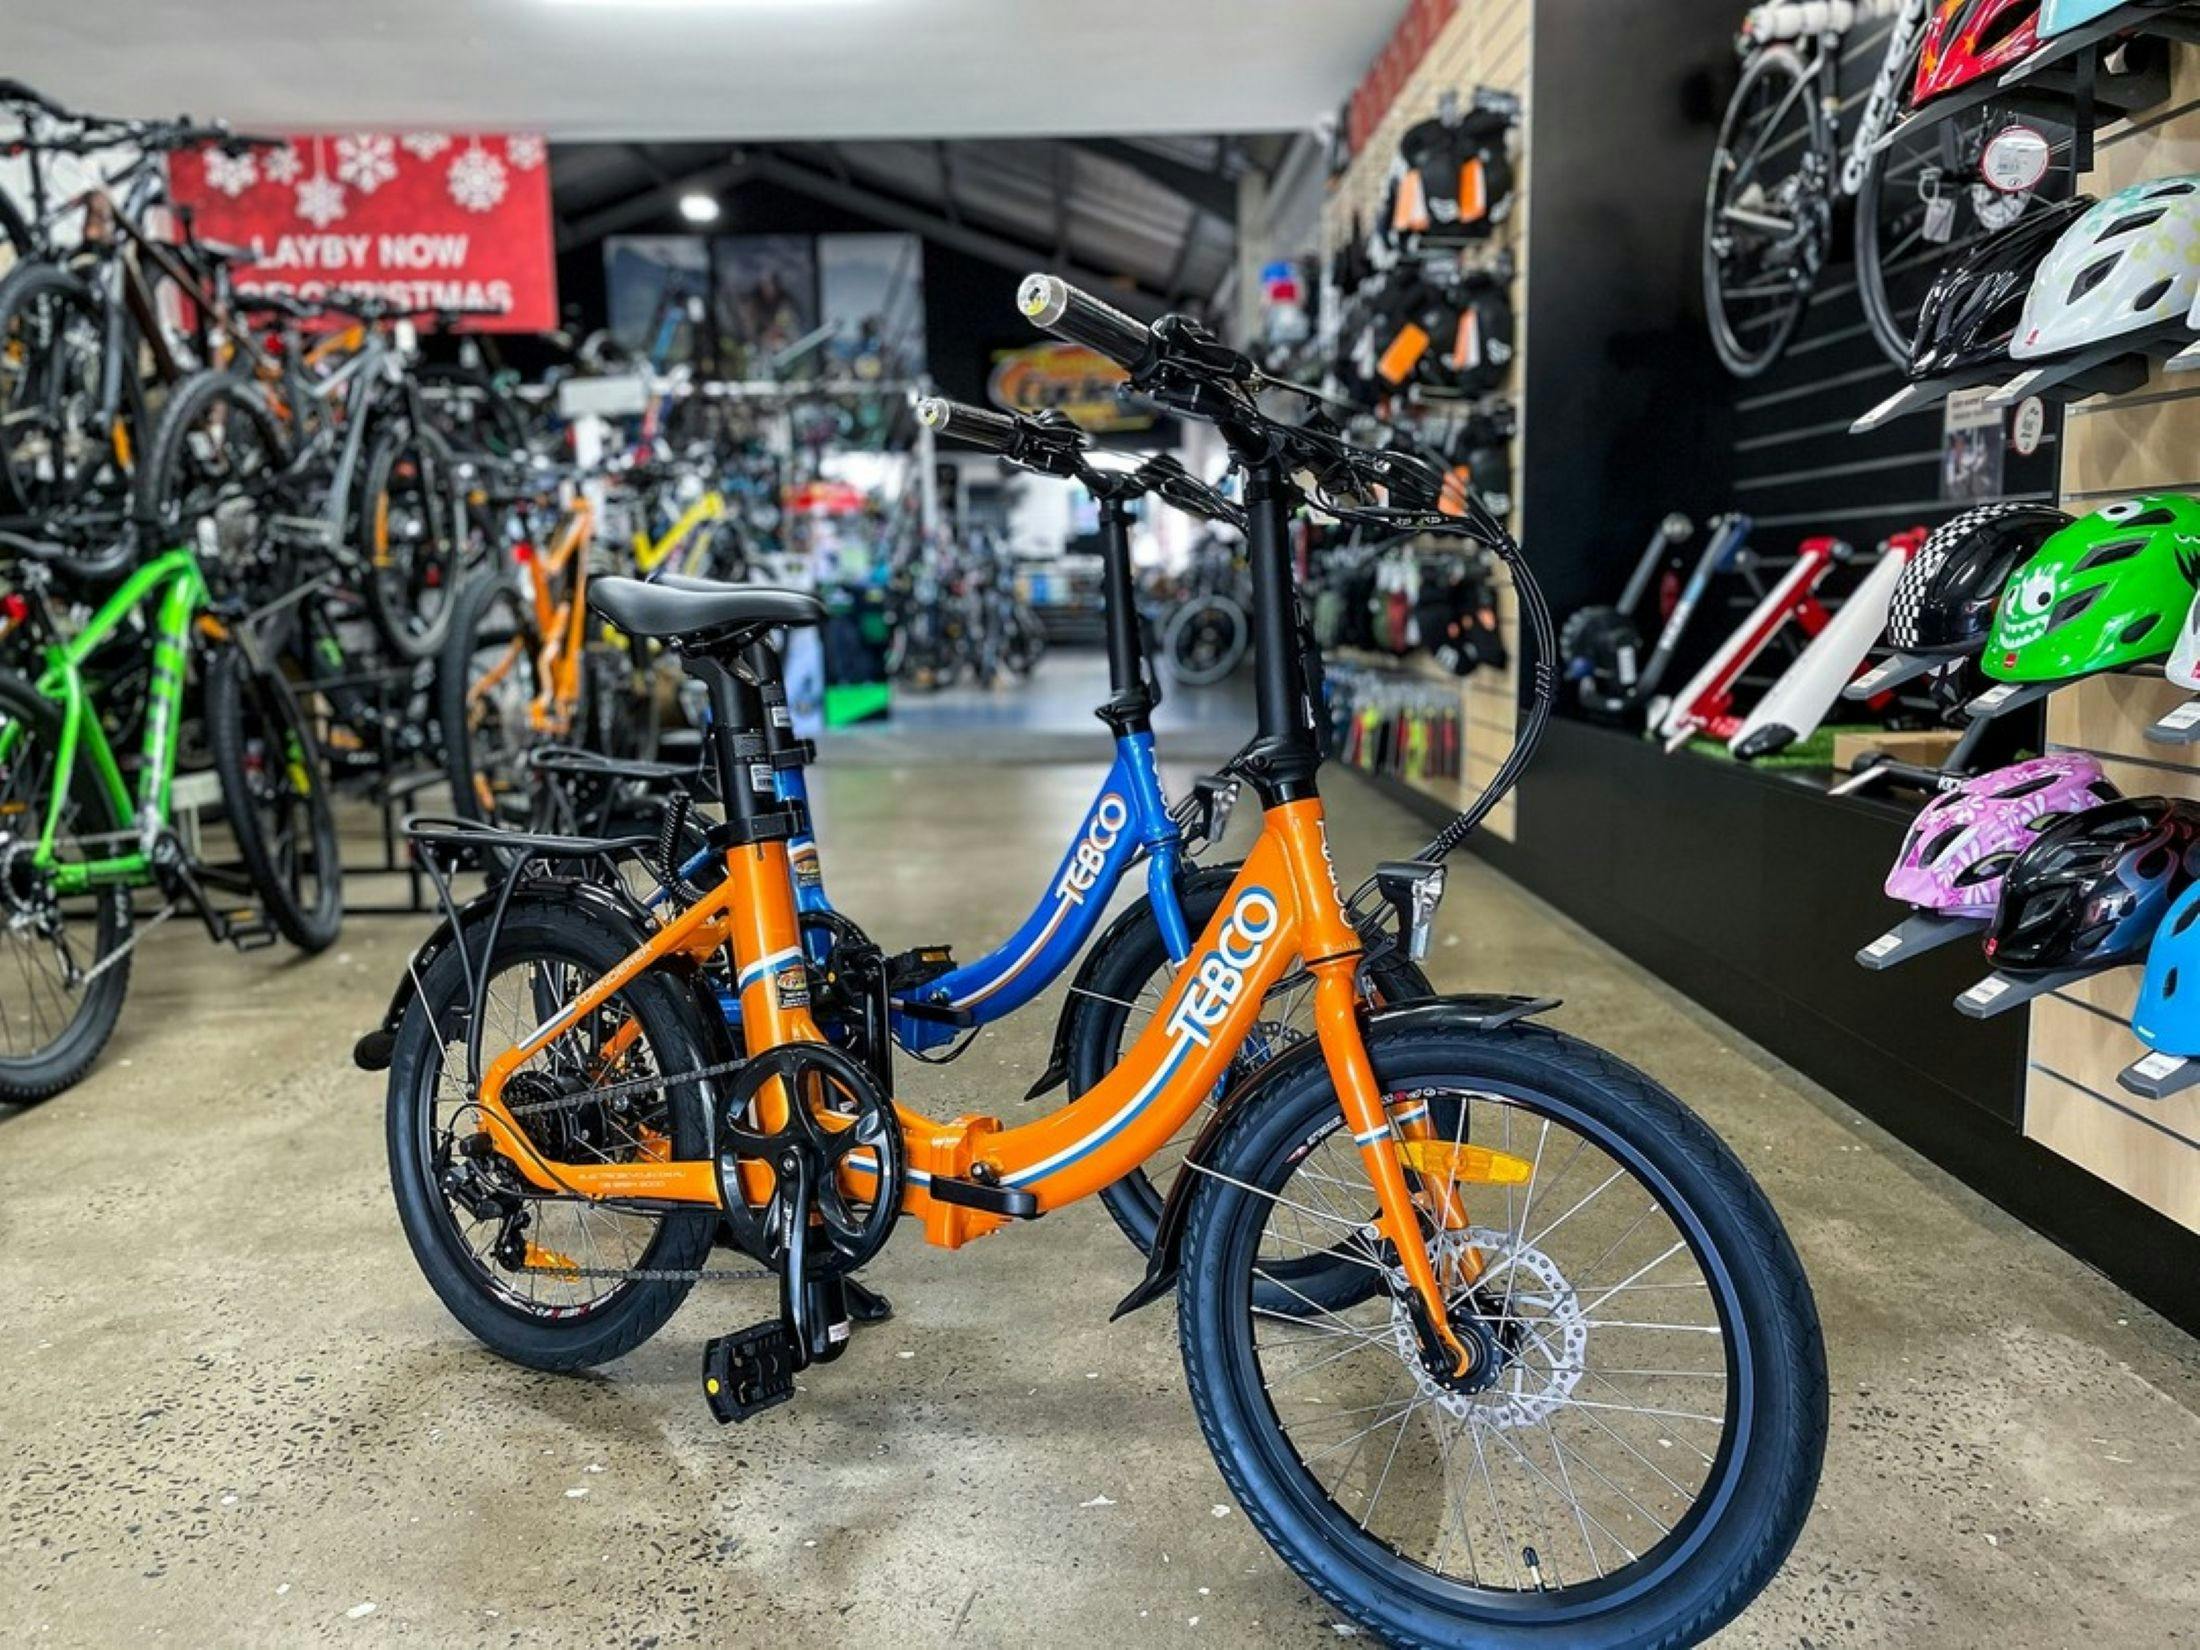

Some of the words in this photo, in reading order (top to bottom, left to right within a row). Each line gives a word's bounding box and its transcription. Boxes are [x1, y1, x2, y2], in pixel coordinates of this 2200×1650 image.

[251, 233, 371, 269] LAYBY
[378, 233, 468, 269] NOW
[1055, 791, 1128, 905] TEBCO
[1164, 885, 1279, 1049] TEBCO
